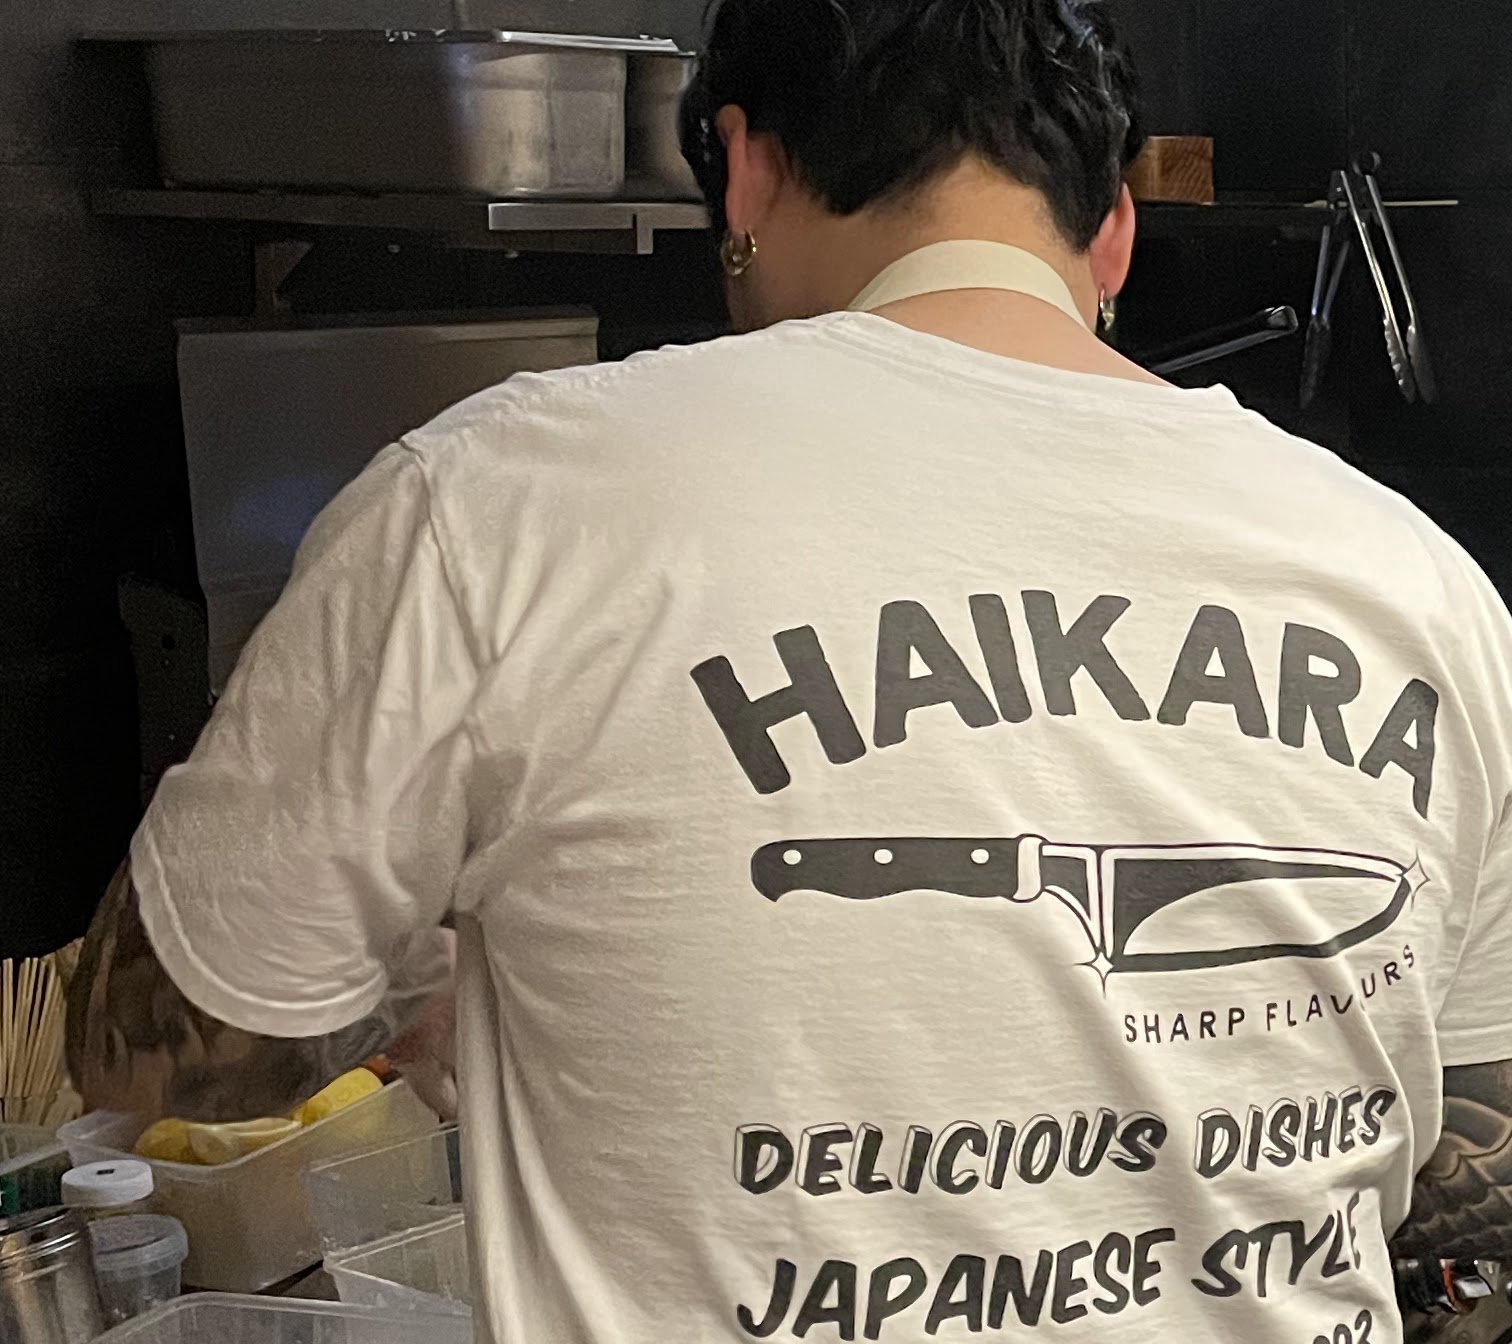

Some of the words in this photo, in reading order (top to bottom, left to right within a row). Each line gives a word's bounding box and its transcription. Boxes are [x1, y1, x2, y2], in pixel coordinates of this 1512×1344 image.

[689, 589, 1439, 818] HAIKARA
[1123, 1007, 1246, 1044] SHARP
[1265, 943, 1416, 1032] FLAVURS
[734, 1106, 1168, 1197] DELICIOUS
[1192, 1085, 1397, 1180] DISHES
[736, 1227, 1176, 1341] JAPANESE
